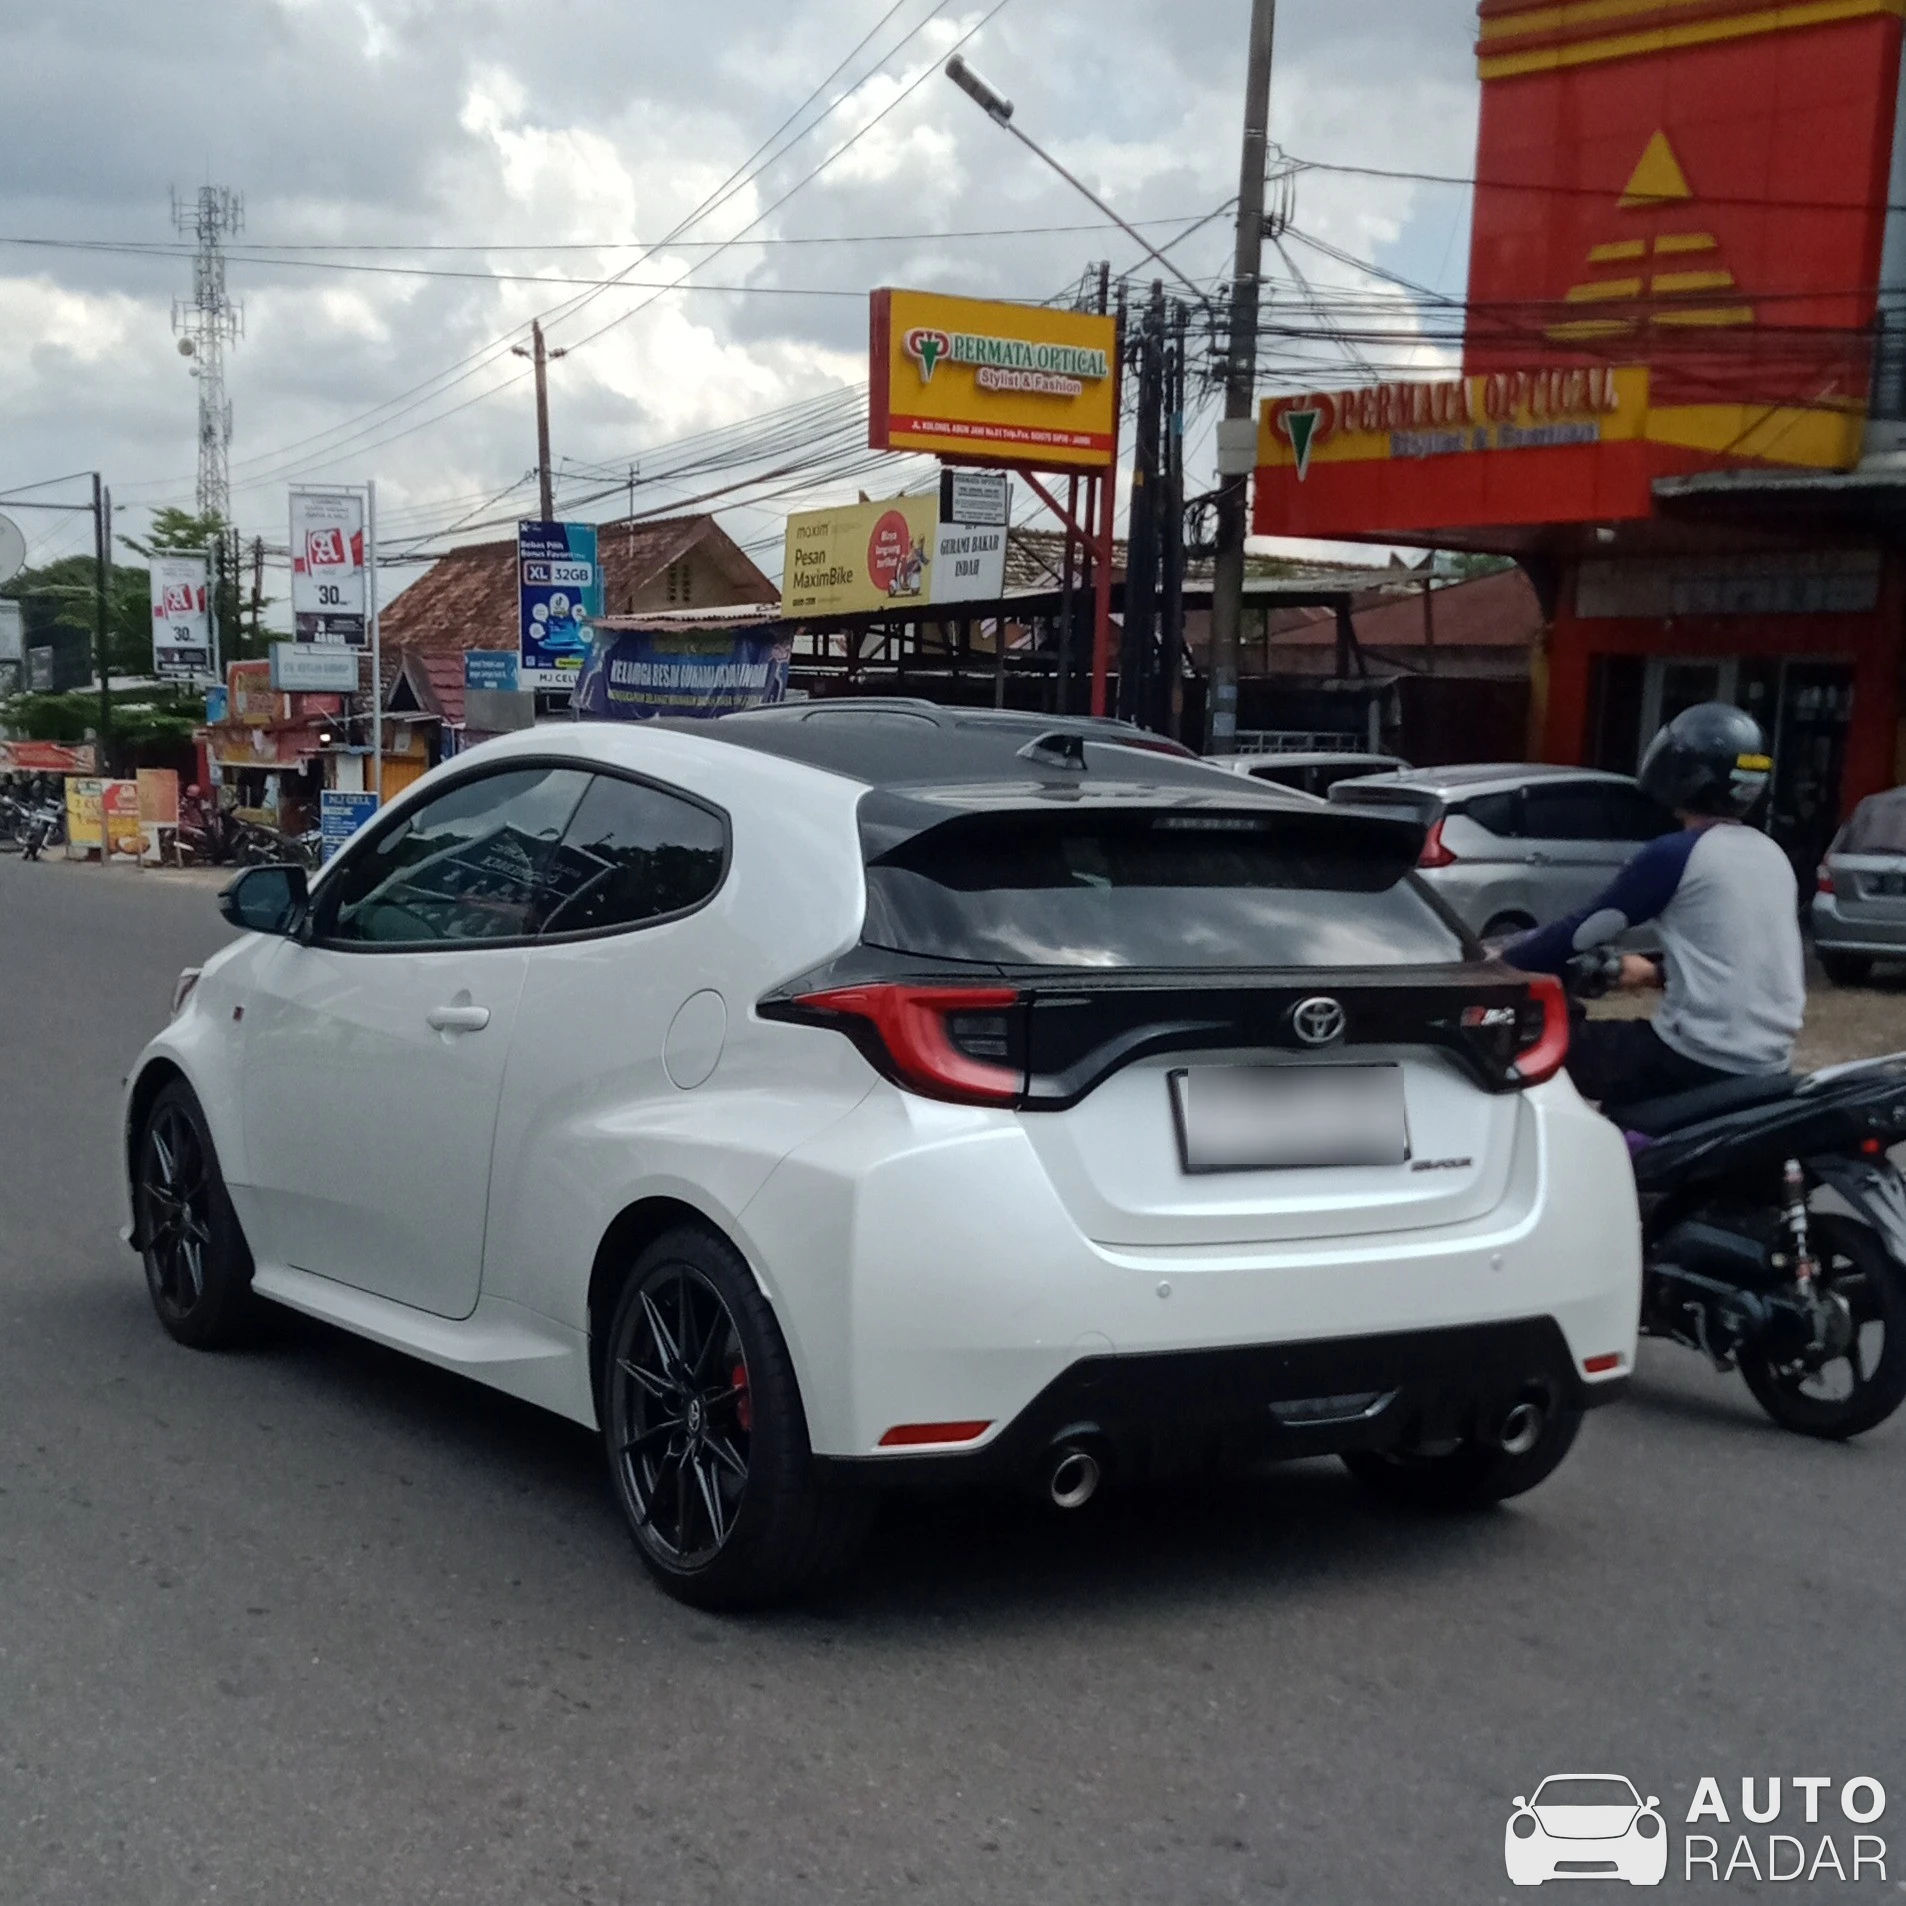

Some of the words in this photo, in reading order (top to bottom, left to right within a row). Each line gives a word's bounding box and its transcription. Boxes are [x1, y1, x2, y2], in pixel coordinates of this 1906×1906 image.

[953, 335, 1034, 367] PERMATA
[1037, 346, 1108, 376] OPTICAL
[979, 369, 1019, 389] Stylist
[1022, 373, 1031, 385] &
[1034, 375, 1081, 394] Fashion
[795, 549, 826, 566] Pesan
[529, 566, 548, 580] XL
[555, 568, 589, 581] 32GB
[793, 567, 853, 589] MaximBike
[318, 585, 340, 605] 30
[173, 625, 190, 641] 30
[540, 674, 553, 682] MJ
